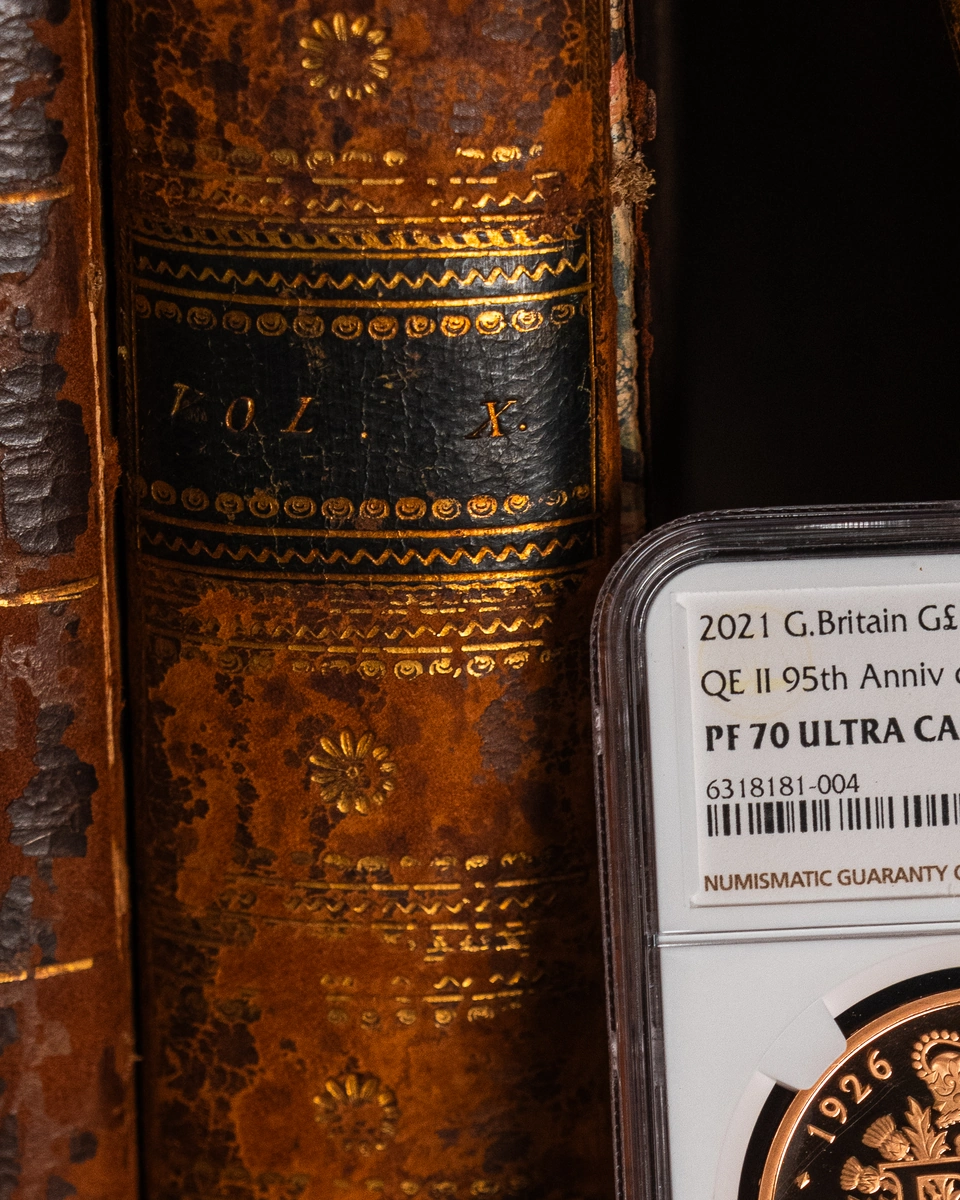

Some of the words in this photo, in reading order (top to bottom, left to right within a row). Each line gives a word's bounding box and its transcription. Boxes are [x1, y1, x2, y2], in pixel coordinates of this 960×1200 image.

[699, 612, 769, 641] 2021
[784, 608, 907, 637] G.Britain
[701, 669, 745, 702] QE
[756, 668, 771, 693] II
[782, 665, 848, 692] 95th
[860, 662, 944, 689] Anniv
[706, 724, 741, 751] PF
[750, 722, 790, 749] 70
[799, 717, 906, 747] ULTRA
[706, 774, 860, 800] 6318181-004
[704, 869, 832, 891] NUMISMATIC
[837, 864, 948, 886] GUARANTY
[806, 1050, 893, 1144] 1926
